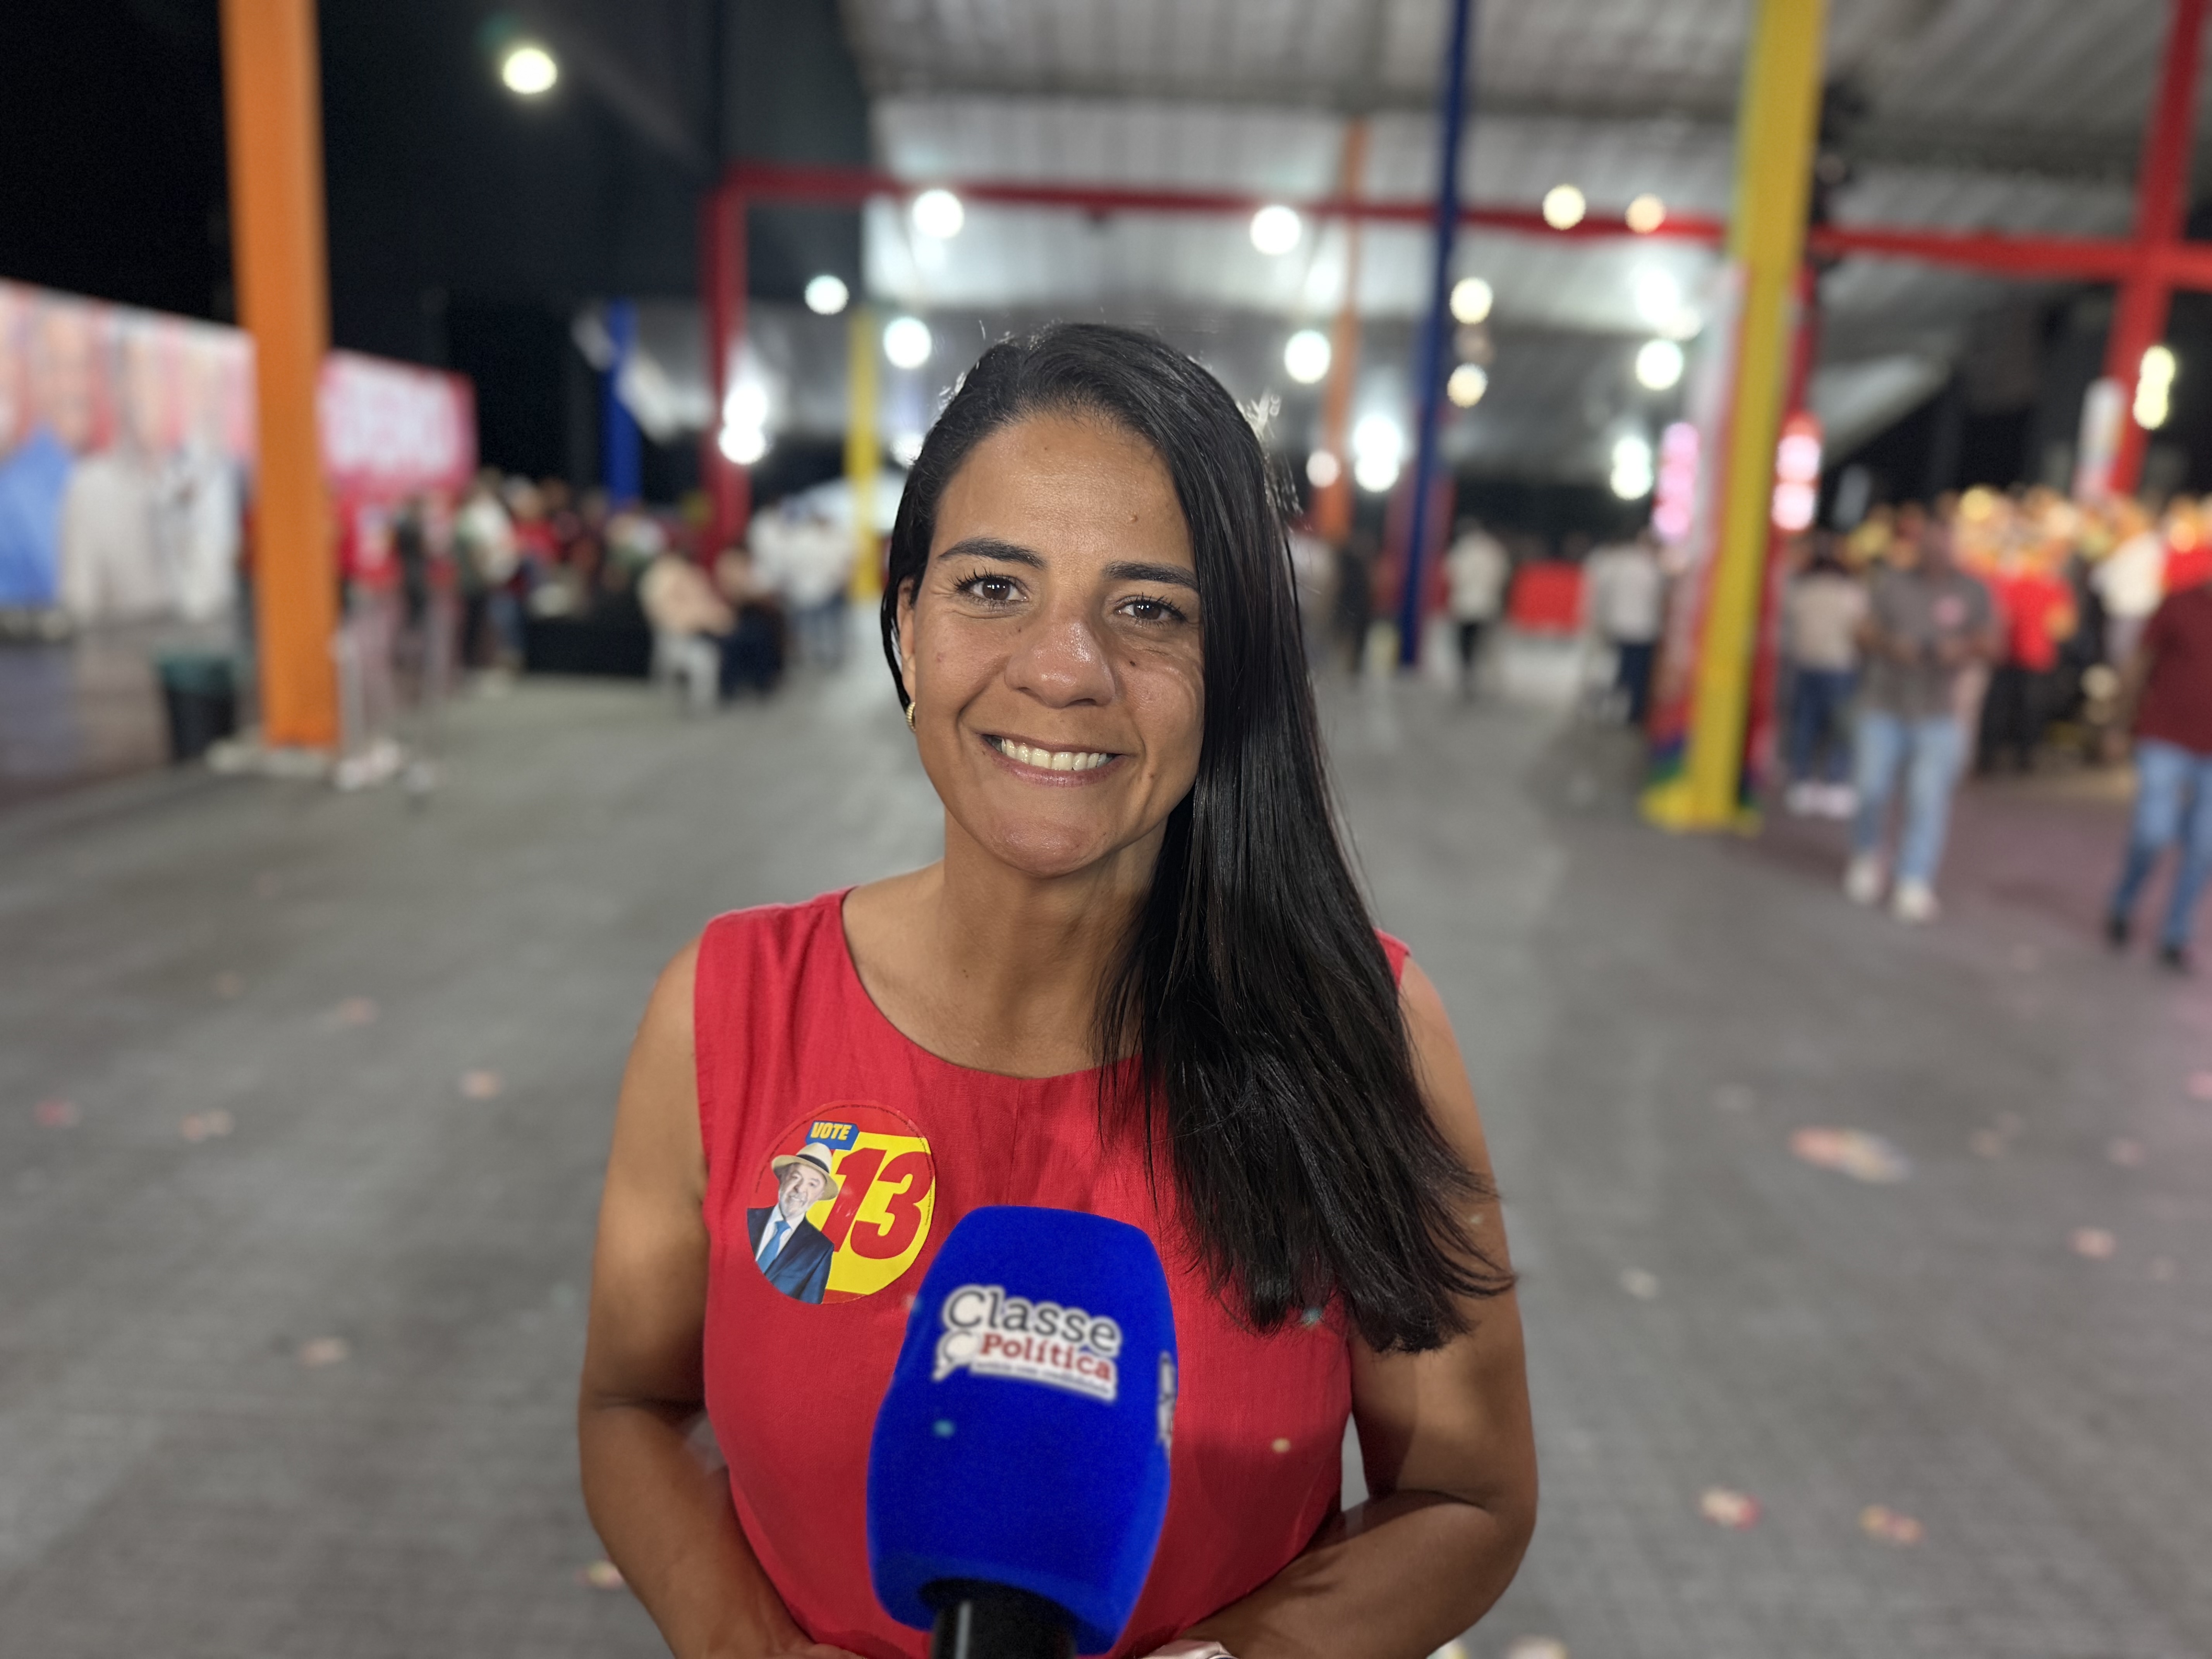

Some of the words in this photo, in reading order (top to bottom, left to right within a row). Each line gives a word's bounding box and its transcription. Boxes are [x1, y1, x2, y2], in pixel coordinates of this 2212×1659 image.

[811, 1122, 852, 1140] VOTE
[821, 1147, 934, 1259] 13
[948, 1290, 1117, 1352] Classe
[979, 1333, 1112, 1382] Política
